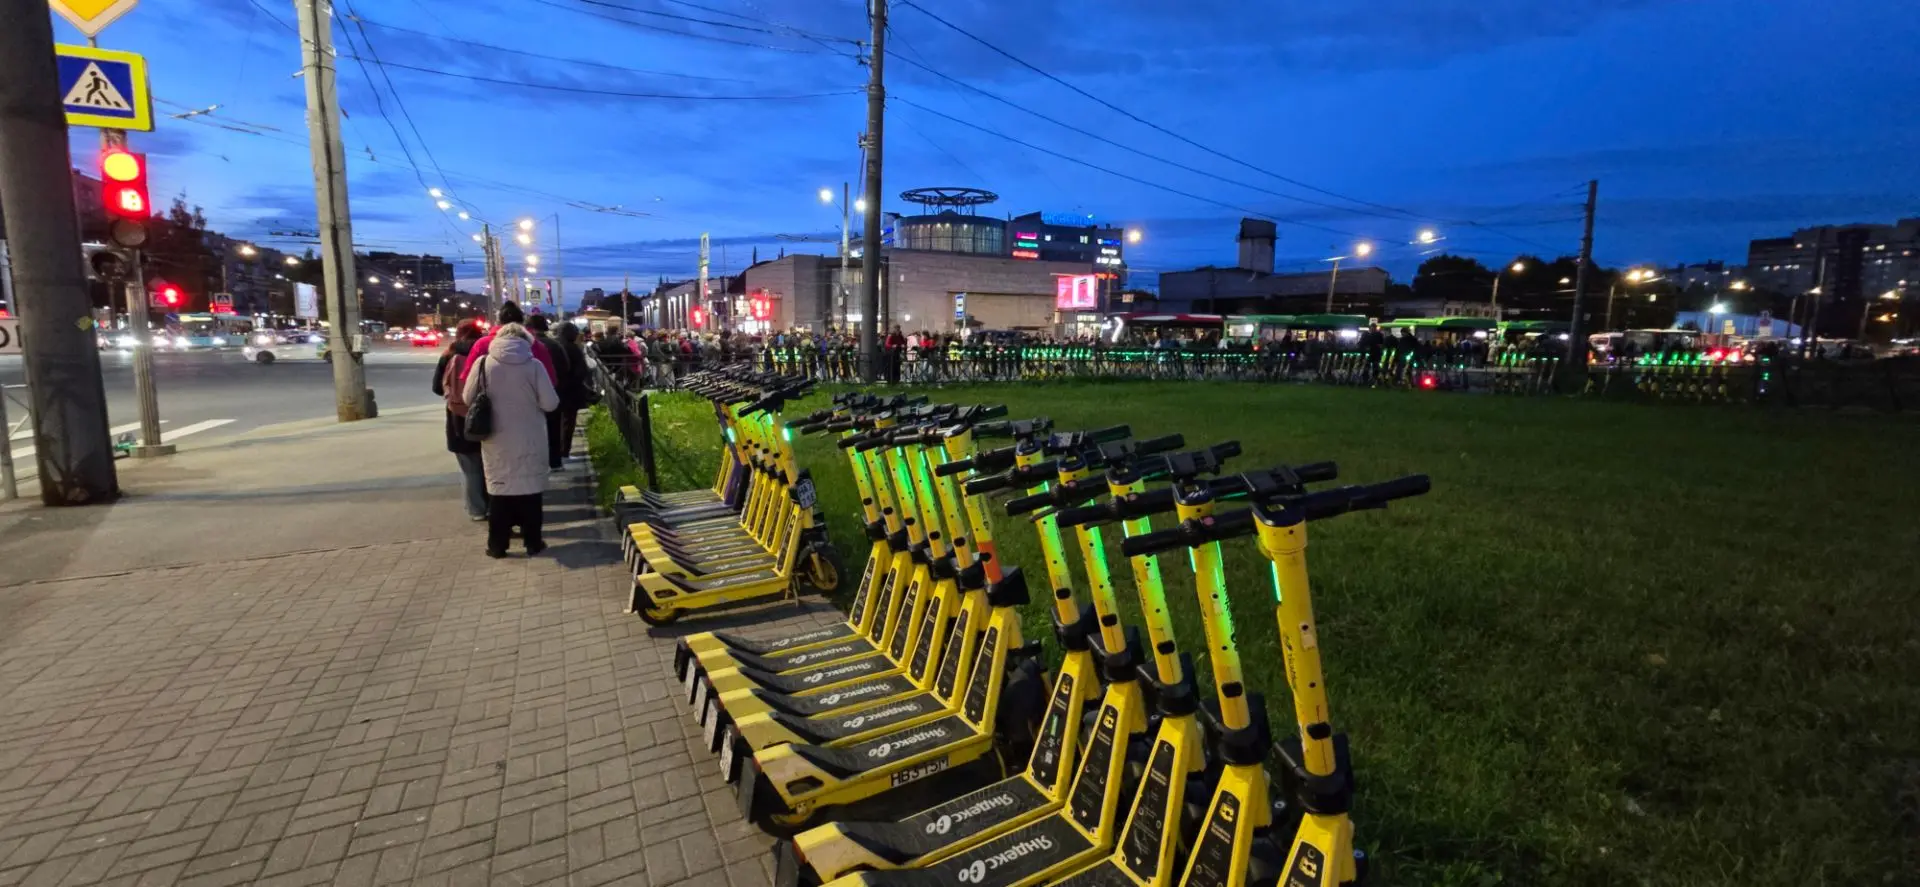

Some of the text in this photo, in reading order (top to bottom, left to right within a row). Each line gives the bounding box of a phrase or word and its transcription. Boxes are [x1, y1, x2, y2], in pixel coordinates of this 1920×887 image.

[867, 703, 918, 721] Яндекс
[868, 727, 947, 757] Яндекс Go
[925, 793, 1014, 835] Яндекс Go
[958, 834, 1053, 884] Яндекс Go
